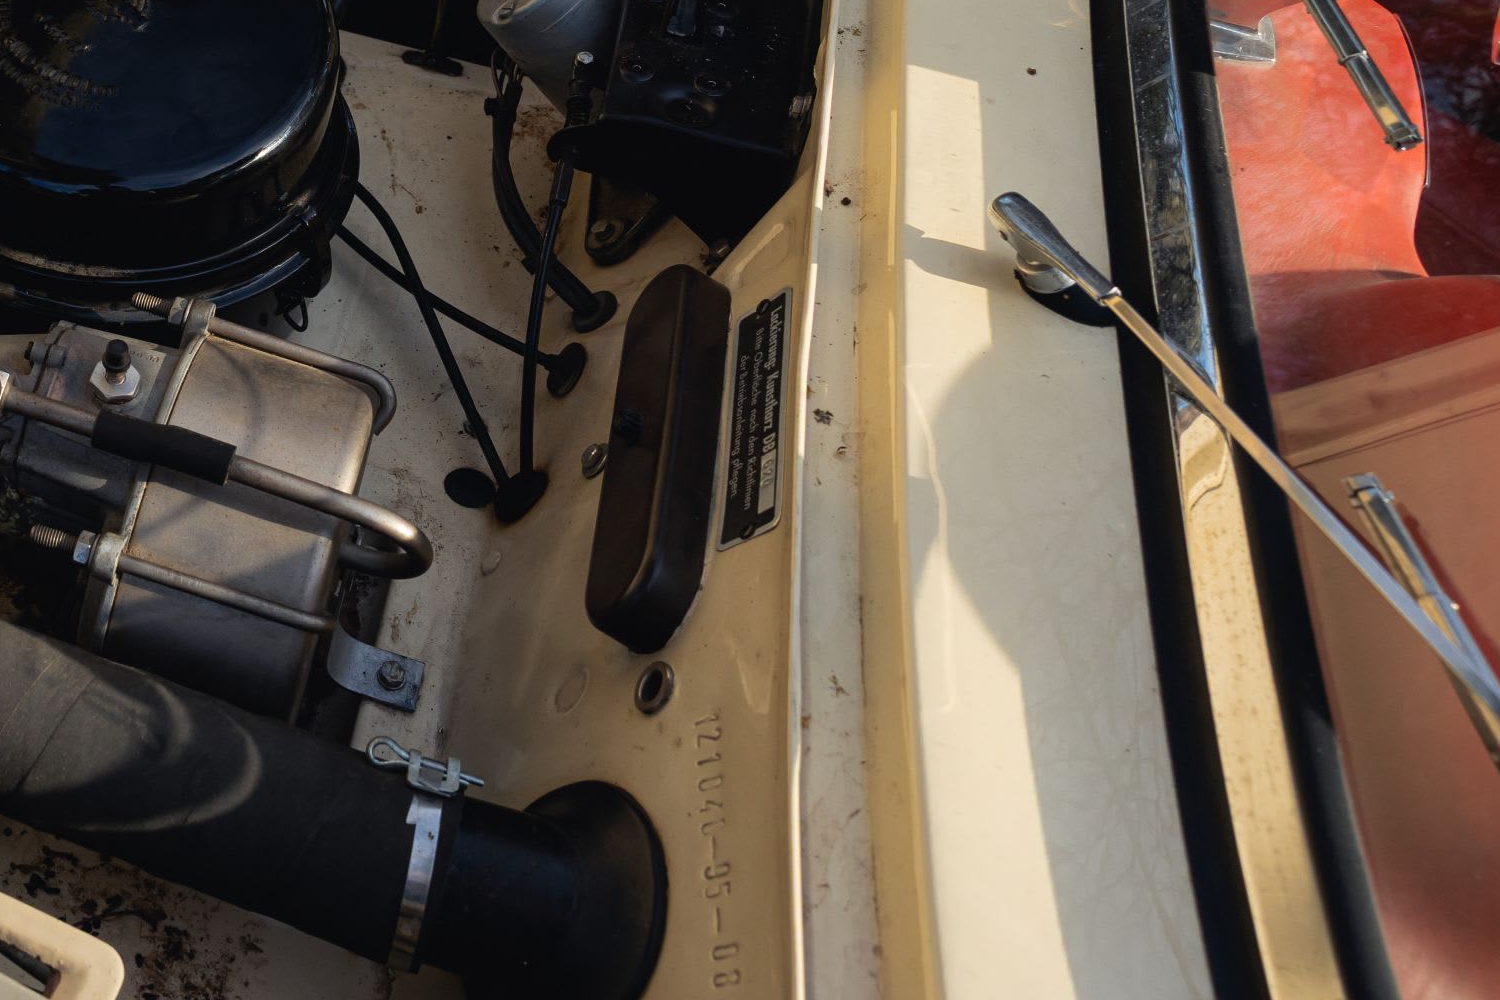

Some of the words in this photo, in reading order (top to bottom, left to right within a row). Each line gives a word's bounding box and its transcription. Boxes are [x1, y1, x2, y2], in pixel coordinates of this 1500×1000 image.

[764, 305, 783, 371] Lackierung:
[740, 354, 750, 371] der
[763, 371, 779, 432] Kunstharz
[749, 408, 759, 433] nach
[748, 435, 759, 456] den
[762, 432, 776, 454] DB
